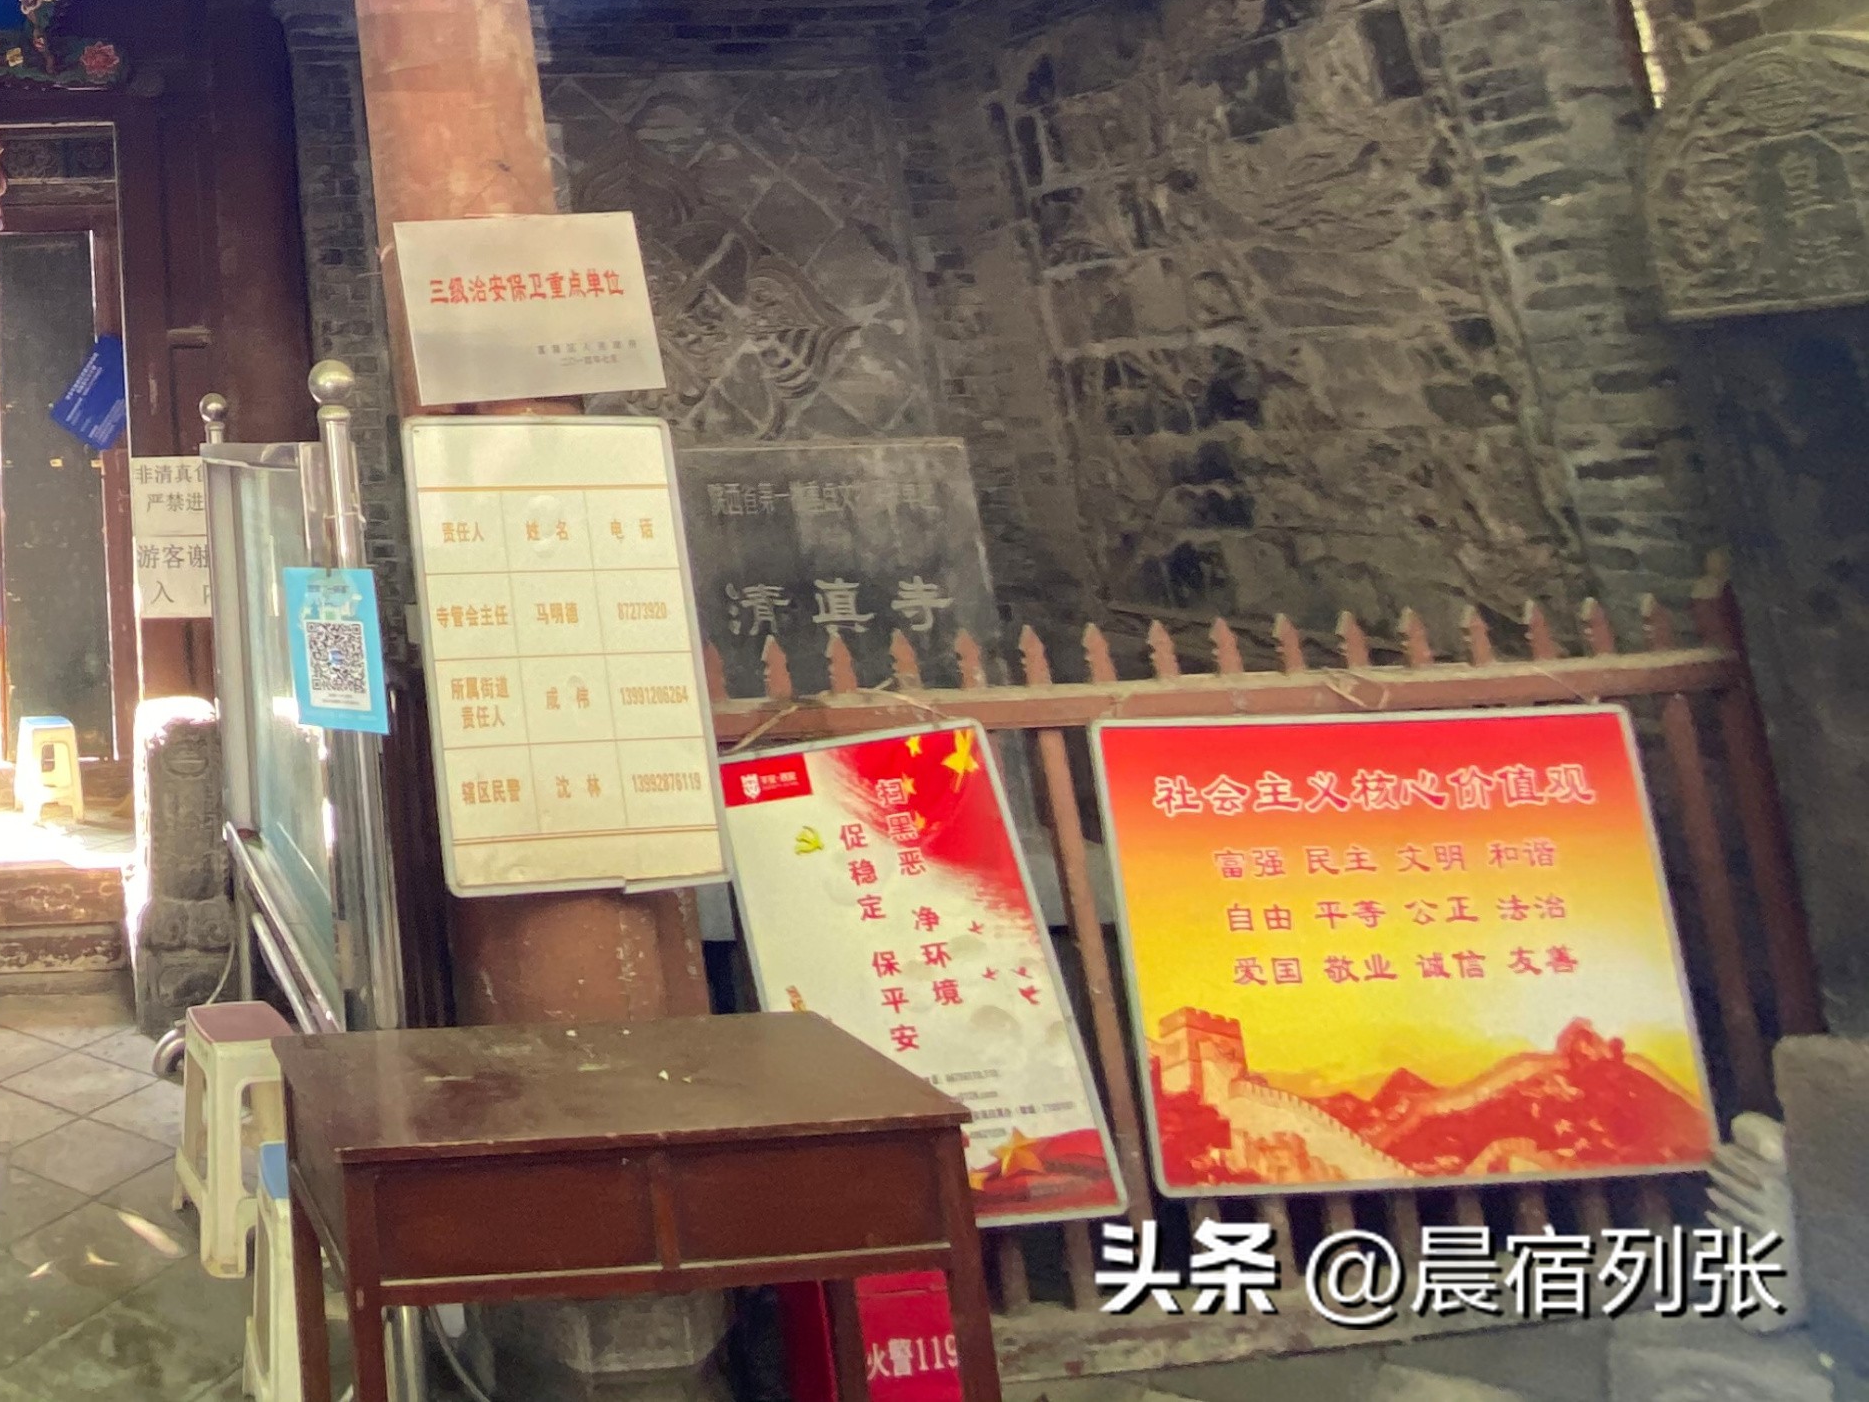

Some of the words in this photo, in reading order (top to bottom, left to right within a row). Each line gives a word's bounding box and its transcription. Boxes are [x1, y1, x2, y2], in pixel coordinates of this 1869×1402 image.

[430, 269, 625, 304] 三级治安保卫重点单位
[442, 521, 484, 544] 责任人
[526, 518, 570, 542] 姓名
[610, 517, 654, 541] 电话
[436, 605, 509, 628] 寺管会主任
[725, 576, 954, 637] 清真寺
[451, 676, 510, 700] 所属街道
[461, 705, 506, 729] 责任人
[461, 778, 520, 805] 辖区民警
[1153, 763, 1598, 818] 社会主义核心价值观
[1213, 847, 1287, 880] 富强
[1305, 845, 1379, 876] 民主
[1397, 843, 1468, 873] 文明
[1487, 838, 1557, 869] 和谐
[876, 778, 927, 877] 扫黑恶
[911, 905, 964, 1006] 净环境
[1226, 902, 1293, 933] 自由
[1314, 899, 1387, 930] 平等
[1404, 895, 1479, 925] 公正
[1496, 893, 1568, 922] 法治
[839, 823, 887, 923] 促稳定
[871, 951, 920, 1053] 保平安
[1232, 955, 1303, 987] 爱国
[1323, 952, 1399, 985] 敬业
[1415, 949, 1487, 981] 诚信
[1506, 944, 1579, 976] 友善
[867, 1334, 959, 1381] 火警119
